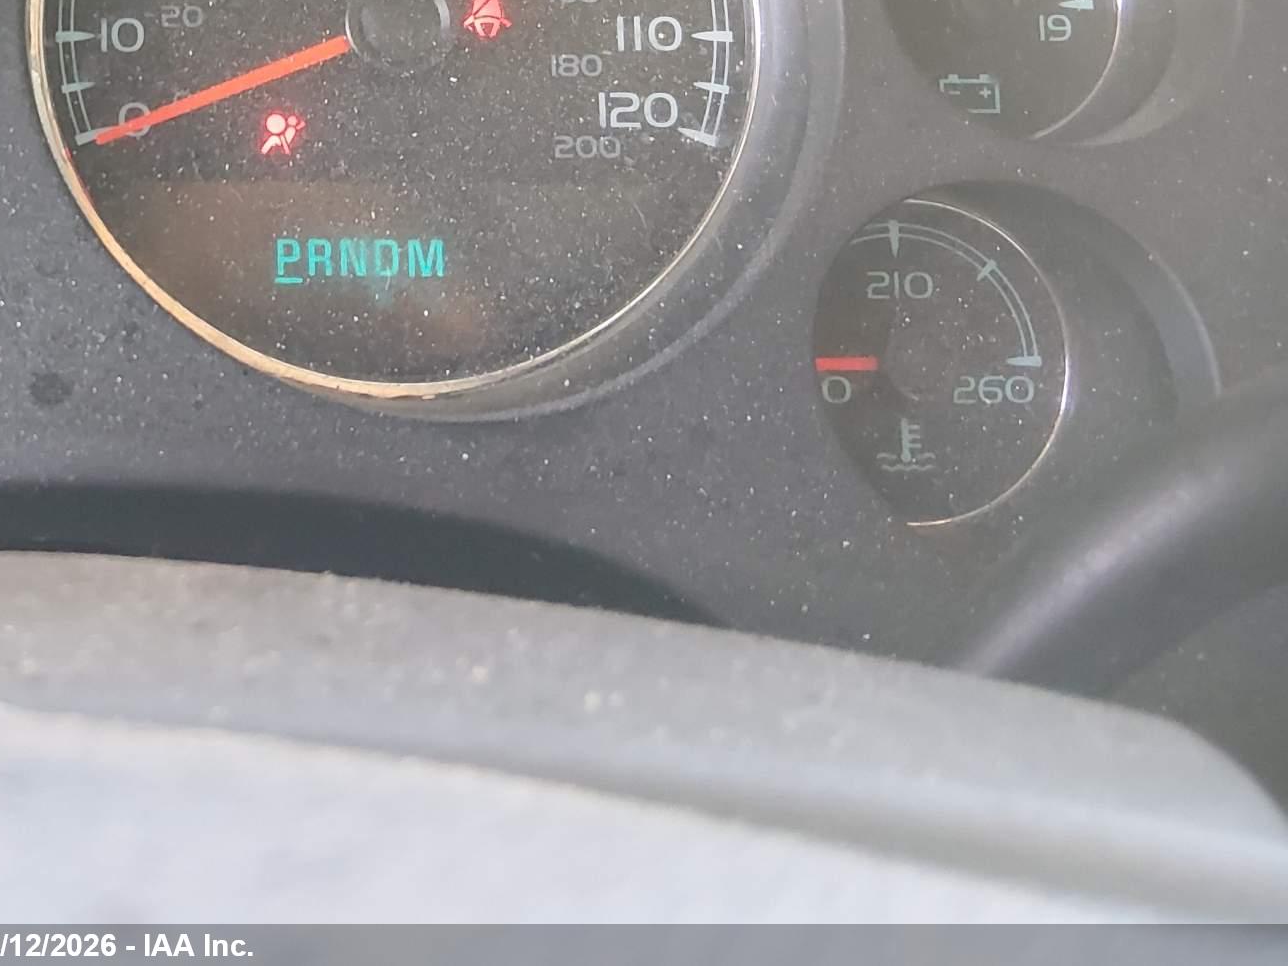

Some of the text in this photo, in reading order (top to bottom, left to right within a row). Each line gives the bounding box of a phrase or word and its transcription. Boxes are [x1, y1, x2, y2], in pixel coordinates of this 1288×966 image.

[162, 6, 204, 29] 20
[1038, 15, 1072, 42] 19
[101, 18, 145, 53] 10
[617, 16, 683, 52] 110
[552, 55, 602, 78] 180
[599, 94, 679, 129] 120
[554, 136, 621, 159] 200
[866, 271, 934, 299] 210
[821, 377, 852, 404] 0
[953, 376, 1034, 404] 260
